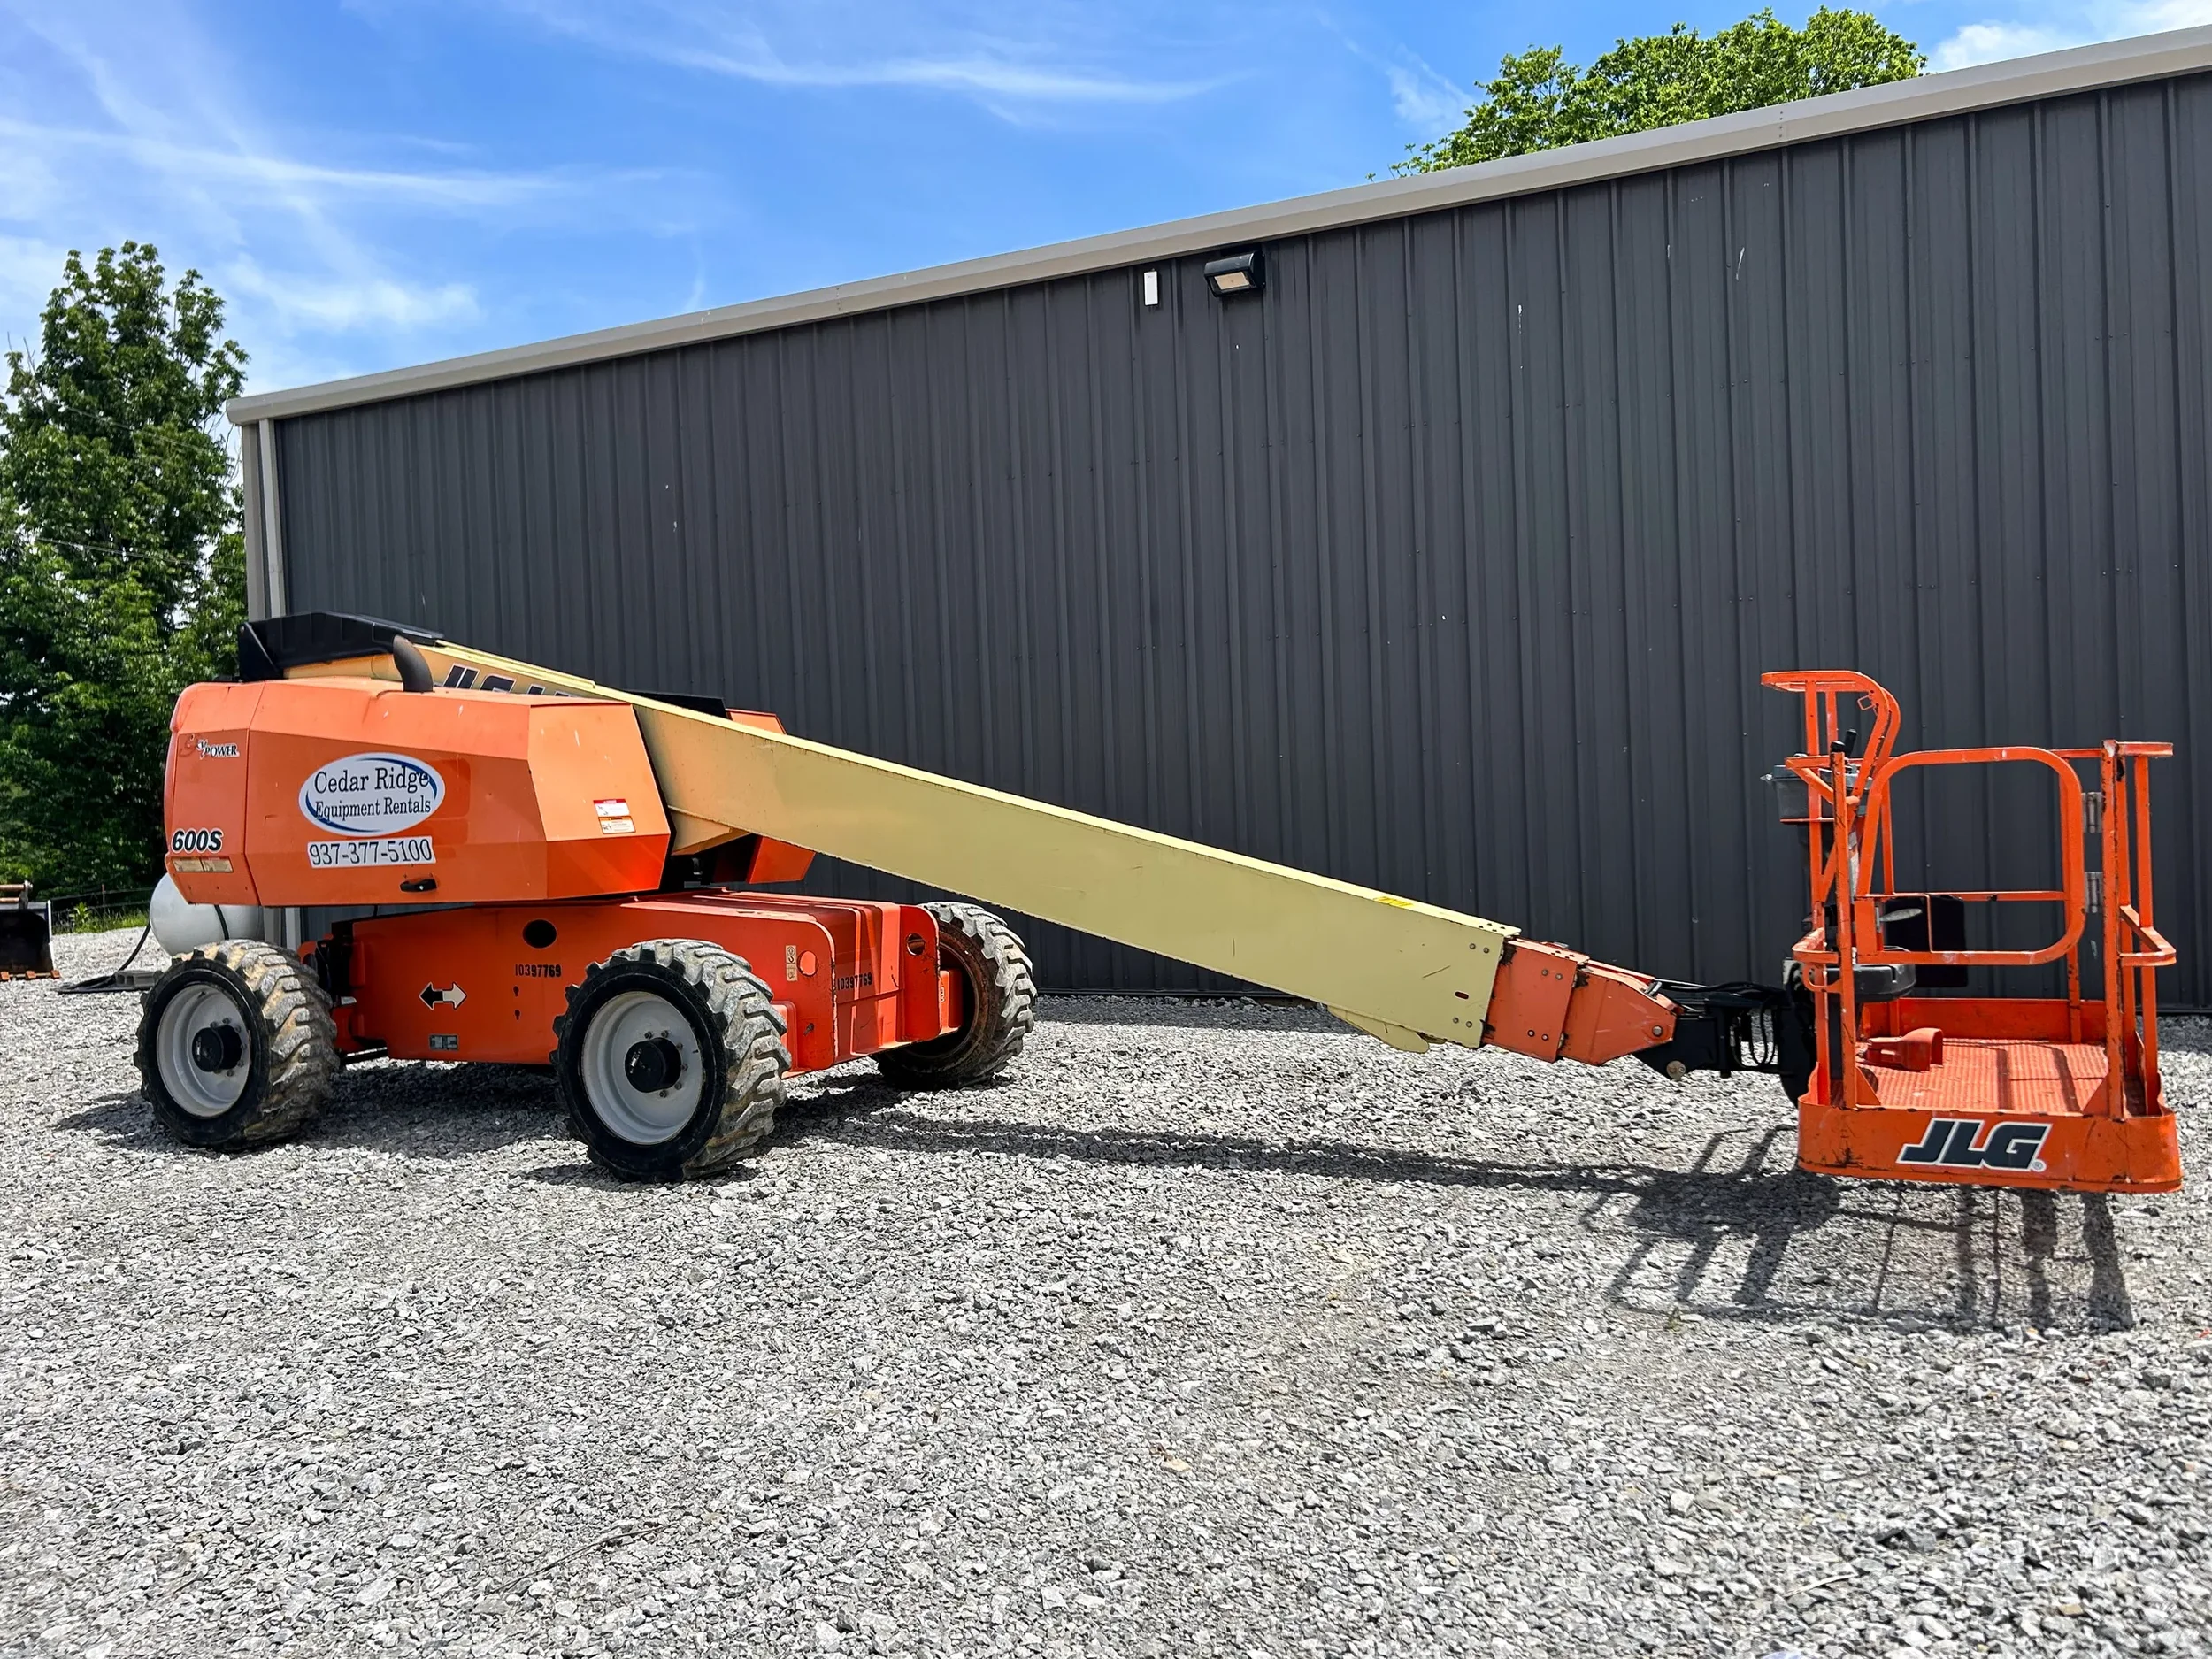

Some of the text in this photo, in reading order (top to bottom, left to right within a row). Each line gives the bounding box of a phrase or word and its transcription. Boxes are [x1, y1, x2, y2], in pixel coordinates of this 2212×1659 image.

[314, 765, 430, 794] Cedar Ridge
[315, 795, 431, 821] Equipment Rentals
[172, 830, 223, 852] 600S
[309, 839, 433, 865] 937-377-5100
[515, 964, 562, 978] 10397769
[1897, 1118, 2051, 1171] JLG
